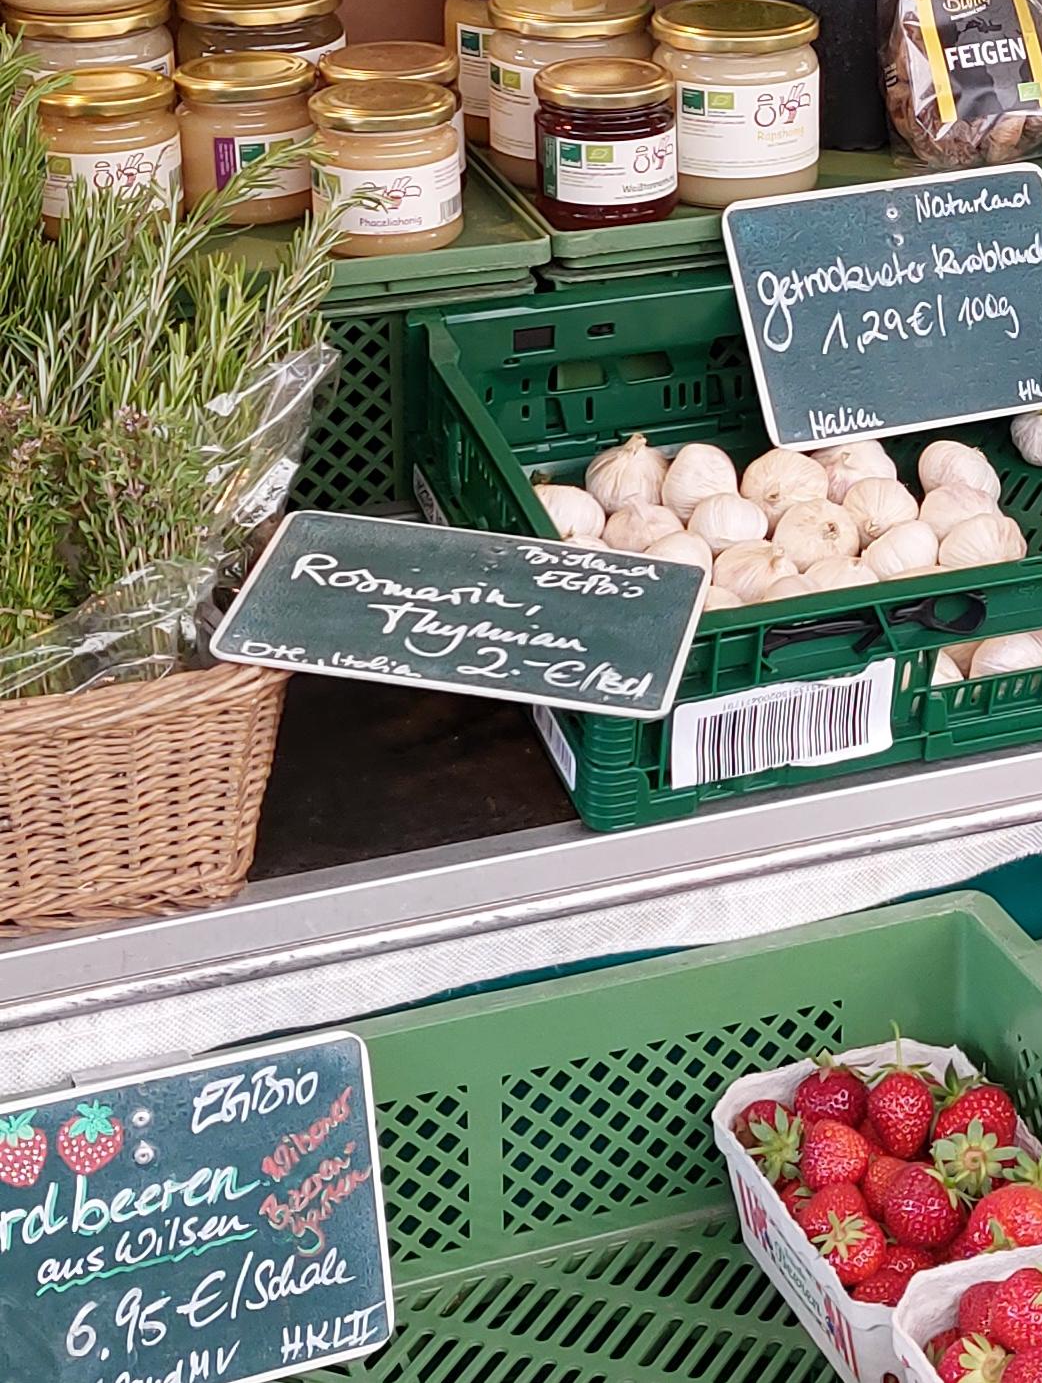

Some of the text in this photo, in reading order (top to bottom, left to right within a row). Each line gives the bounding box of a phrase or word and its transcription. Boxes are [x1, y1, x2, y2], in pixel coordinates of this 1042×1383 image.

[944, 37, 1027, 71] FEIGEN
[915, 183, 1031, 223] Naturland
[516, 545, 660, 581] Bioland
[367, 603, 588, 657] Thymian
[0, 1166, 262, 1252] rdbeeren
[37, 1245, 105, 1286] aus
[115, 1216, 252, 1265] Wilsen
